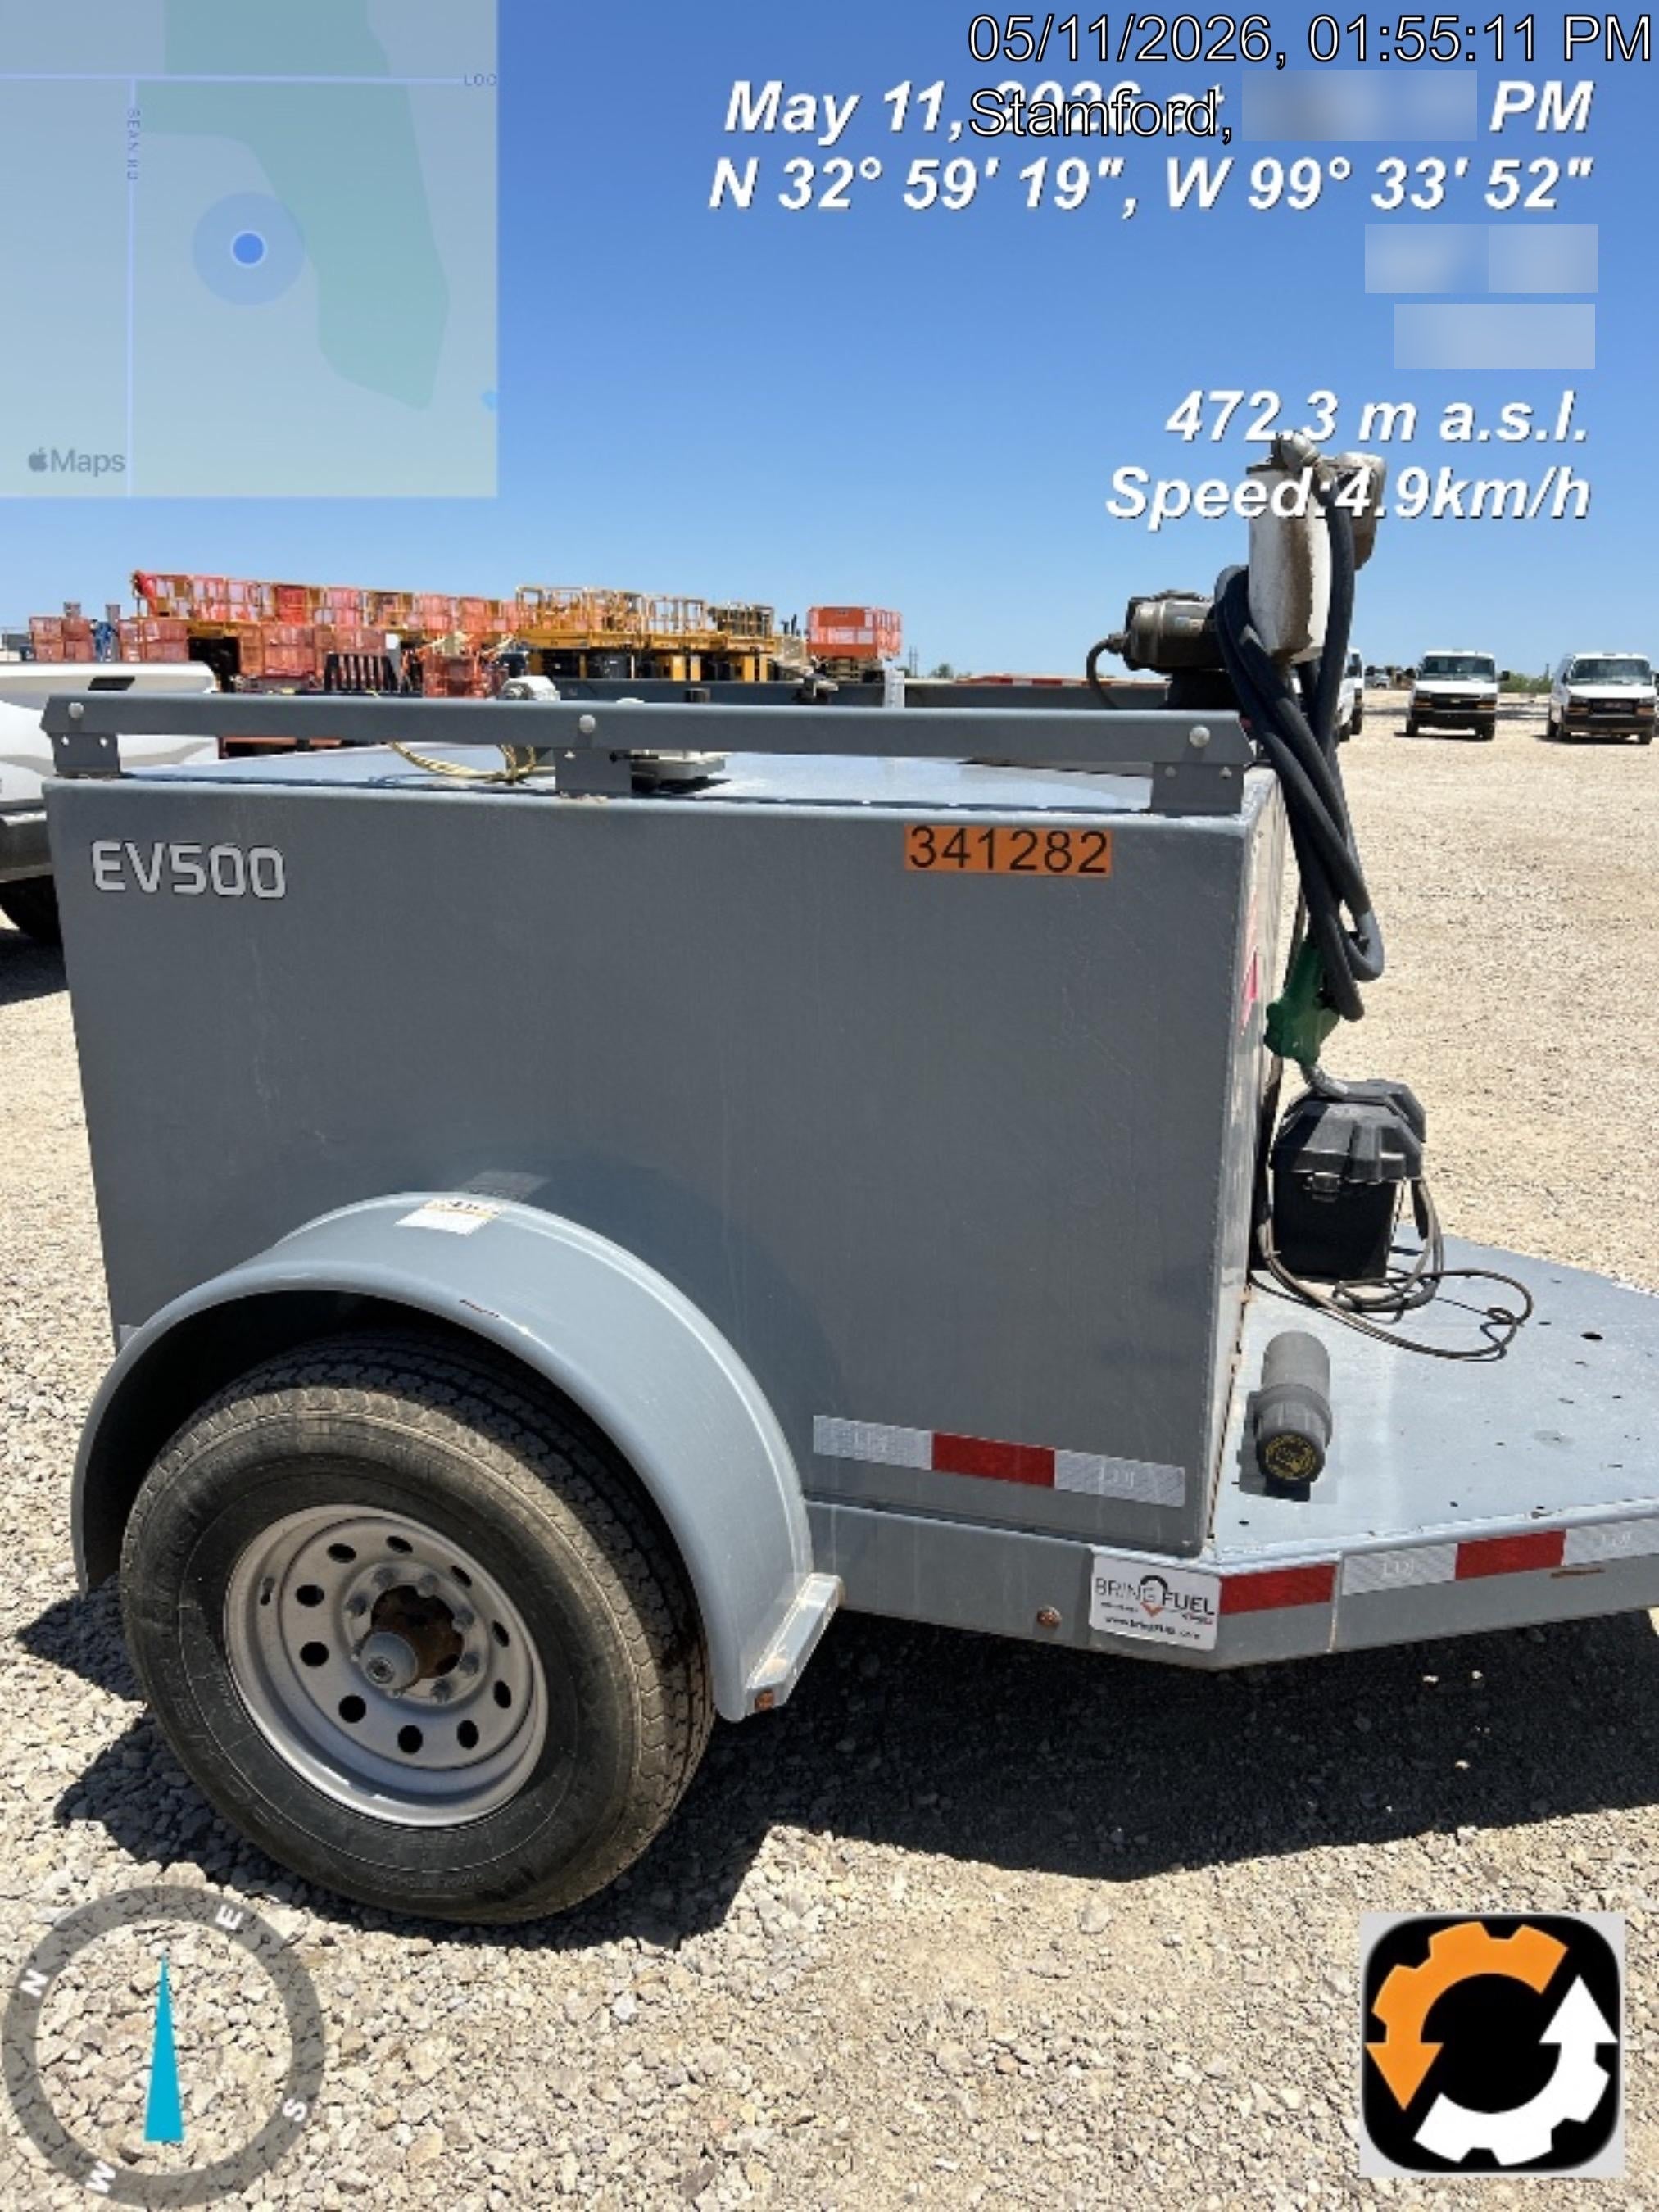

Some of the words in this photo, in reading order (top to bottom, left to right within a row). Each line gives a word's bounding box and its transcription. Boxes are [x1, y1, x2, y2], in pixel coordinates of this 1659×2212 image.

[92, 840, 286, 899] EV500
[909, 825, 1107, 873] 341282
[1162, 1592, 1216, 1616] FUEL
